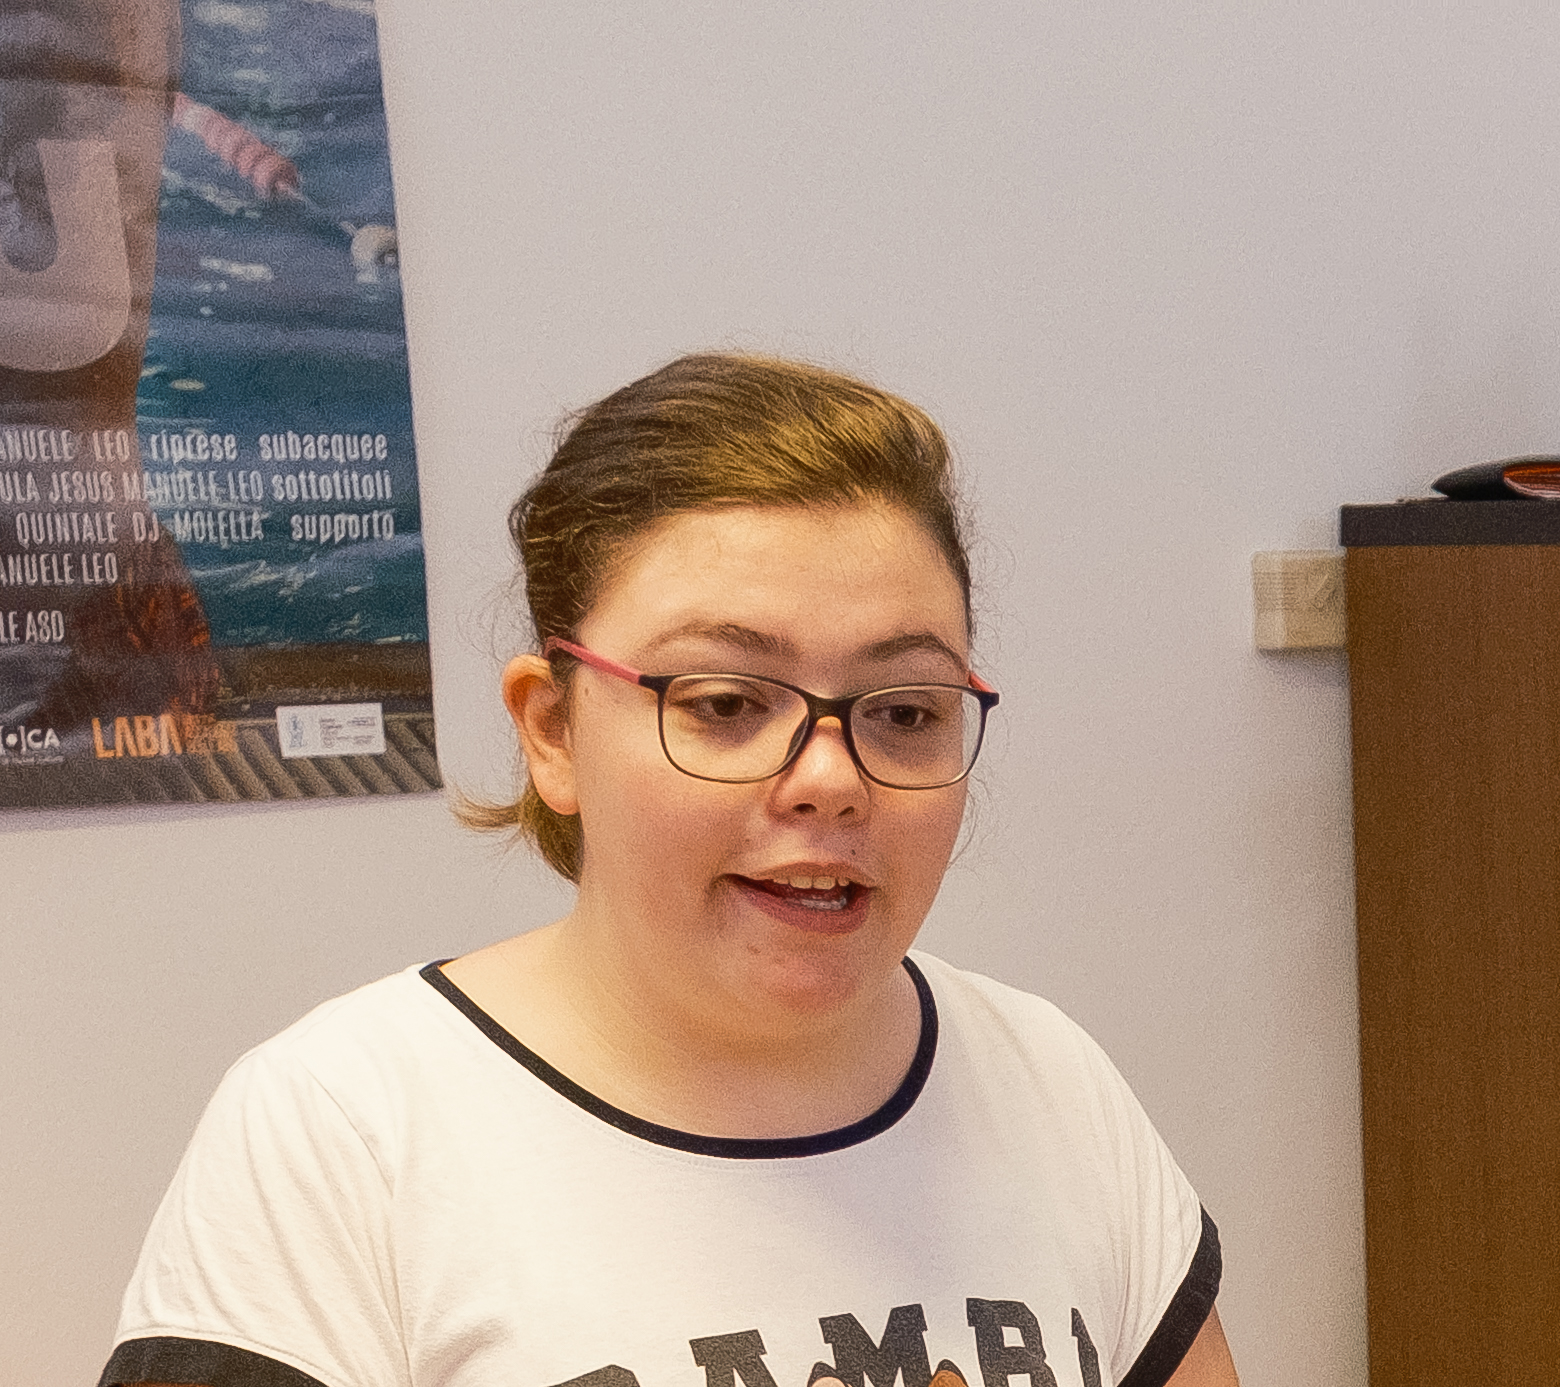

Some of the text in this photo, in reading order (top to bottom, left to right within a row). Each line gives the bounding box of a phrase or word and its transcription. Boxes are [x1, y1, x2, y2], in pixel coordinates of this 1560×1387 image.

[93, 429, 131, 461] LEO
[149, 428, 238, 464] riprese
[259, 430, 388, 464] subacquee
[50, 471, 117, 501] JESUS
[123, 470, 219, 502] MANUELE
[227, 470, 264, 500] LEO
[271, 470, 393, 501] sottotitoli
[16, 512, 118, 549] QUINTALE
[133, 512, 160, 543] DJ
[174, 511, 264, 547] MOLELLA
[290, 511, 395, 545] supporto
[82, 552, 118, 586] LEO
[25, 610, 65, 643] ASD
